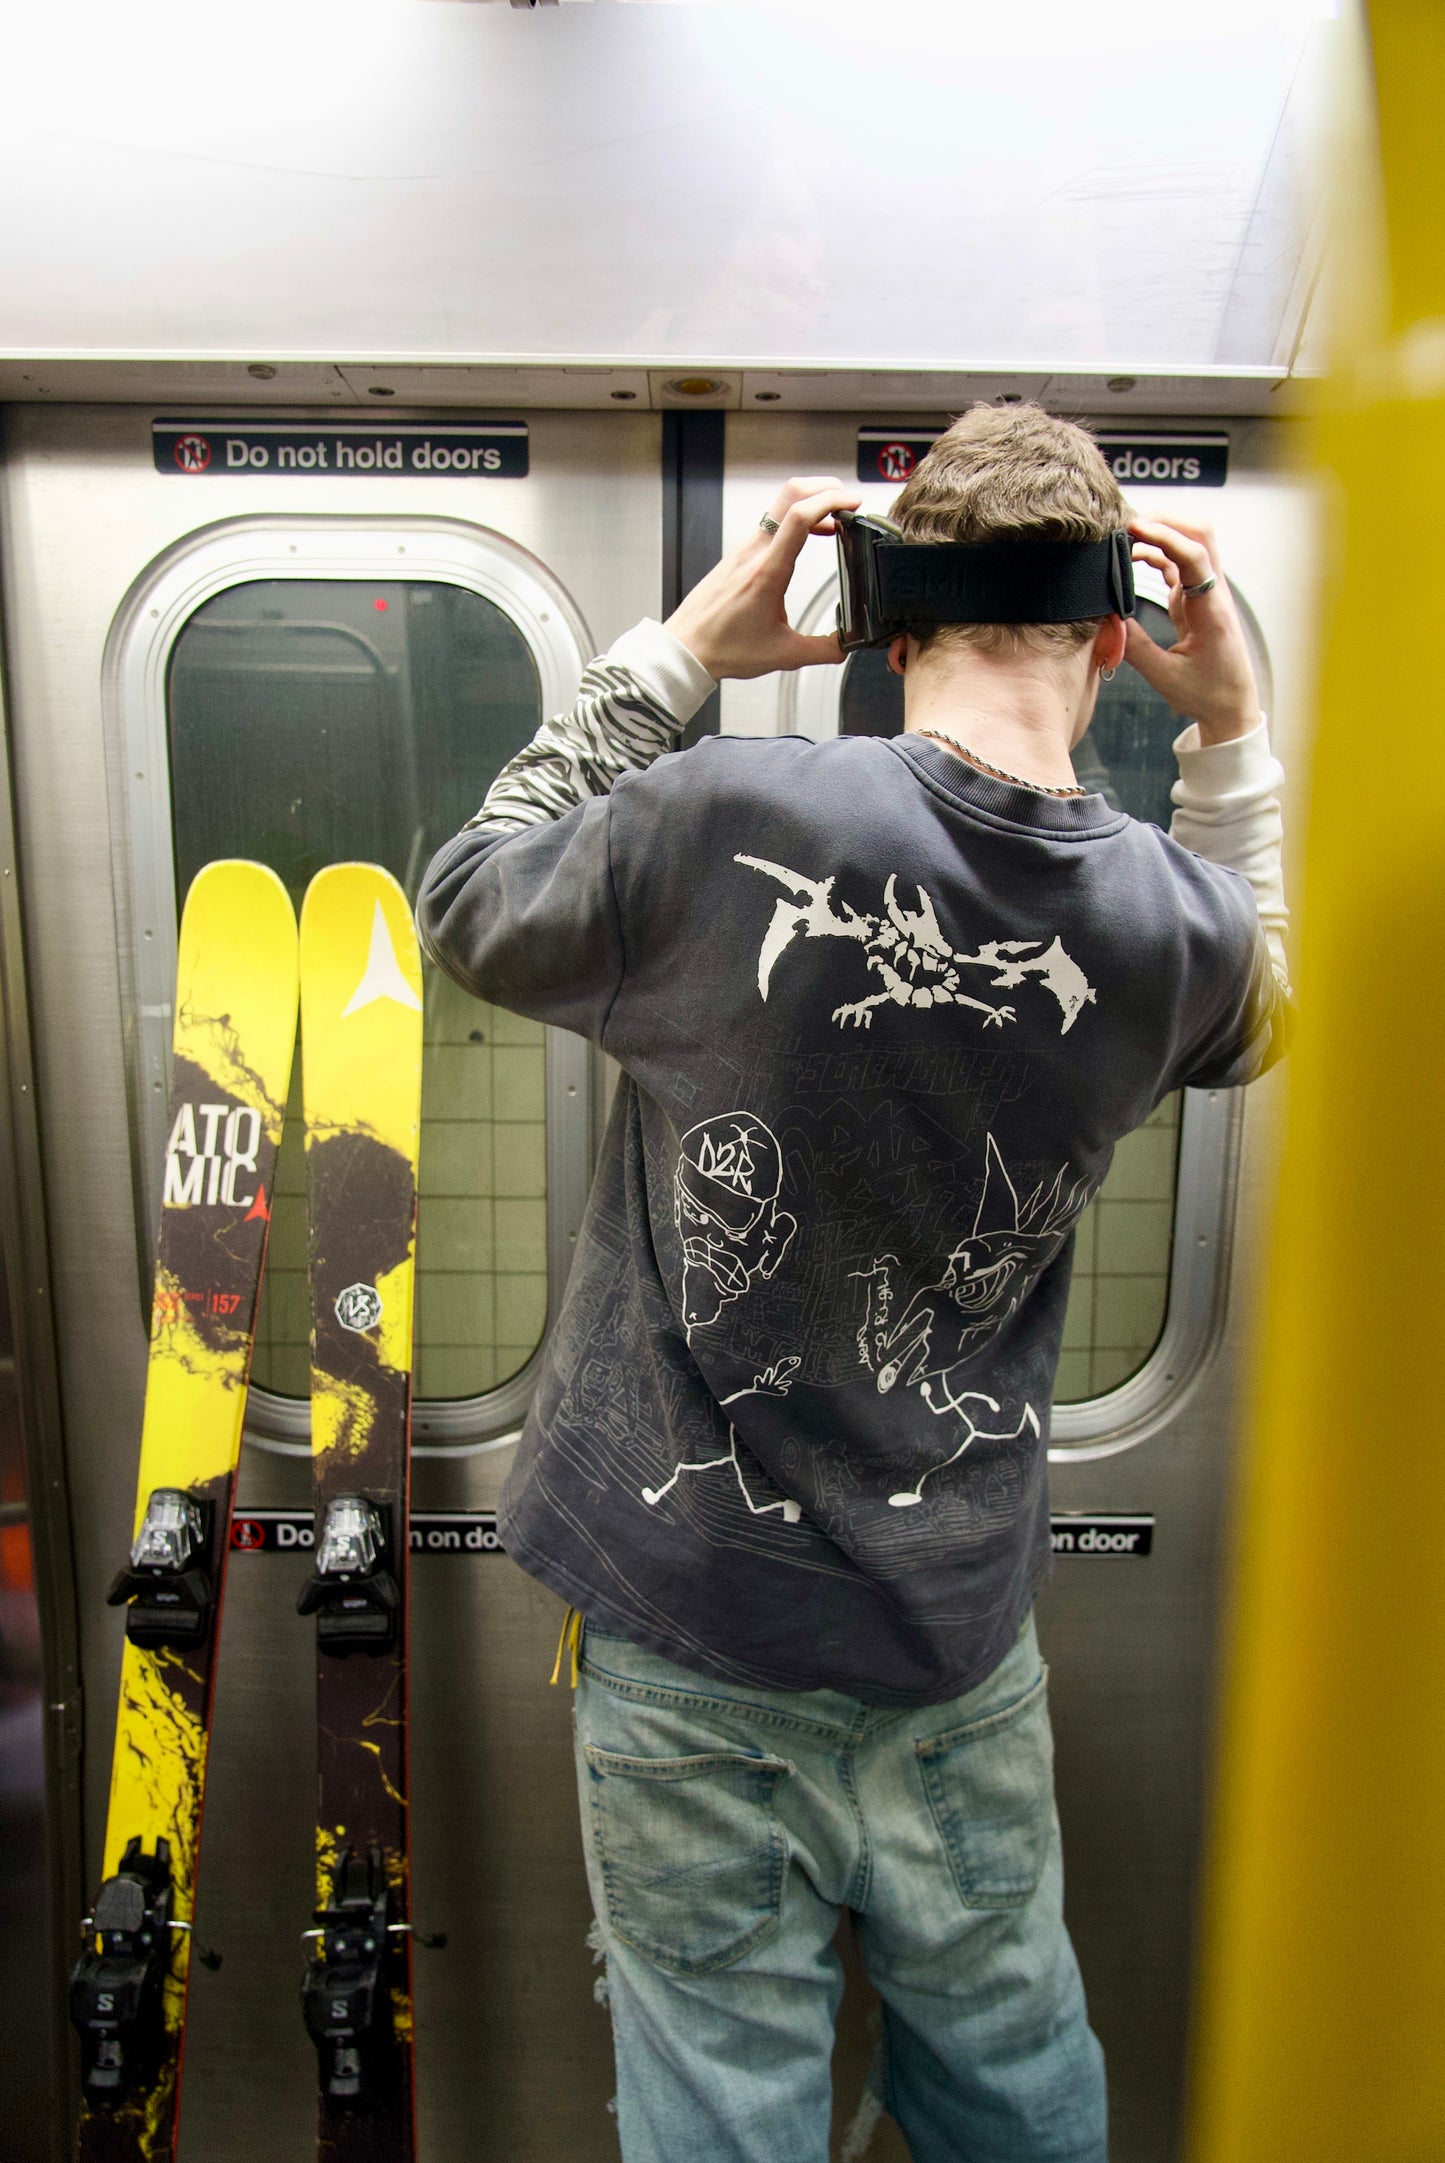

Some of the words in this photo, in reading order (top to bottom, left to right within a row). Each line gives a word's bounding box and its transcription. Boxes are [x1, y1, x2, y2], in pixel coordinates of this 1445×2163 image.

[226, 439, 268, 467] Do
[277, 442, 327, 468] not
[336, 441, 402, 469] hold
[411, 442, 501, 470] doors
[1113, 450, 1201, 480] doors
[166, 1102, 261, 1158] ATO
[162, 1154, 257, 1207] MIC
[212, 1294, 241, 1314] 157
[276, 1524, 315, 1547] Do
[427, 1531, 460, 1547] on
[465, 1526, 500, 1548] do
[1078, 1528, 1140, 1552] door
